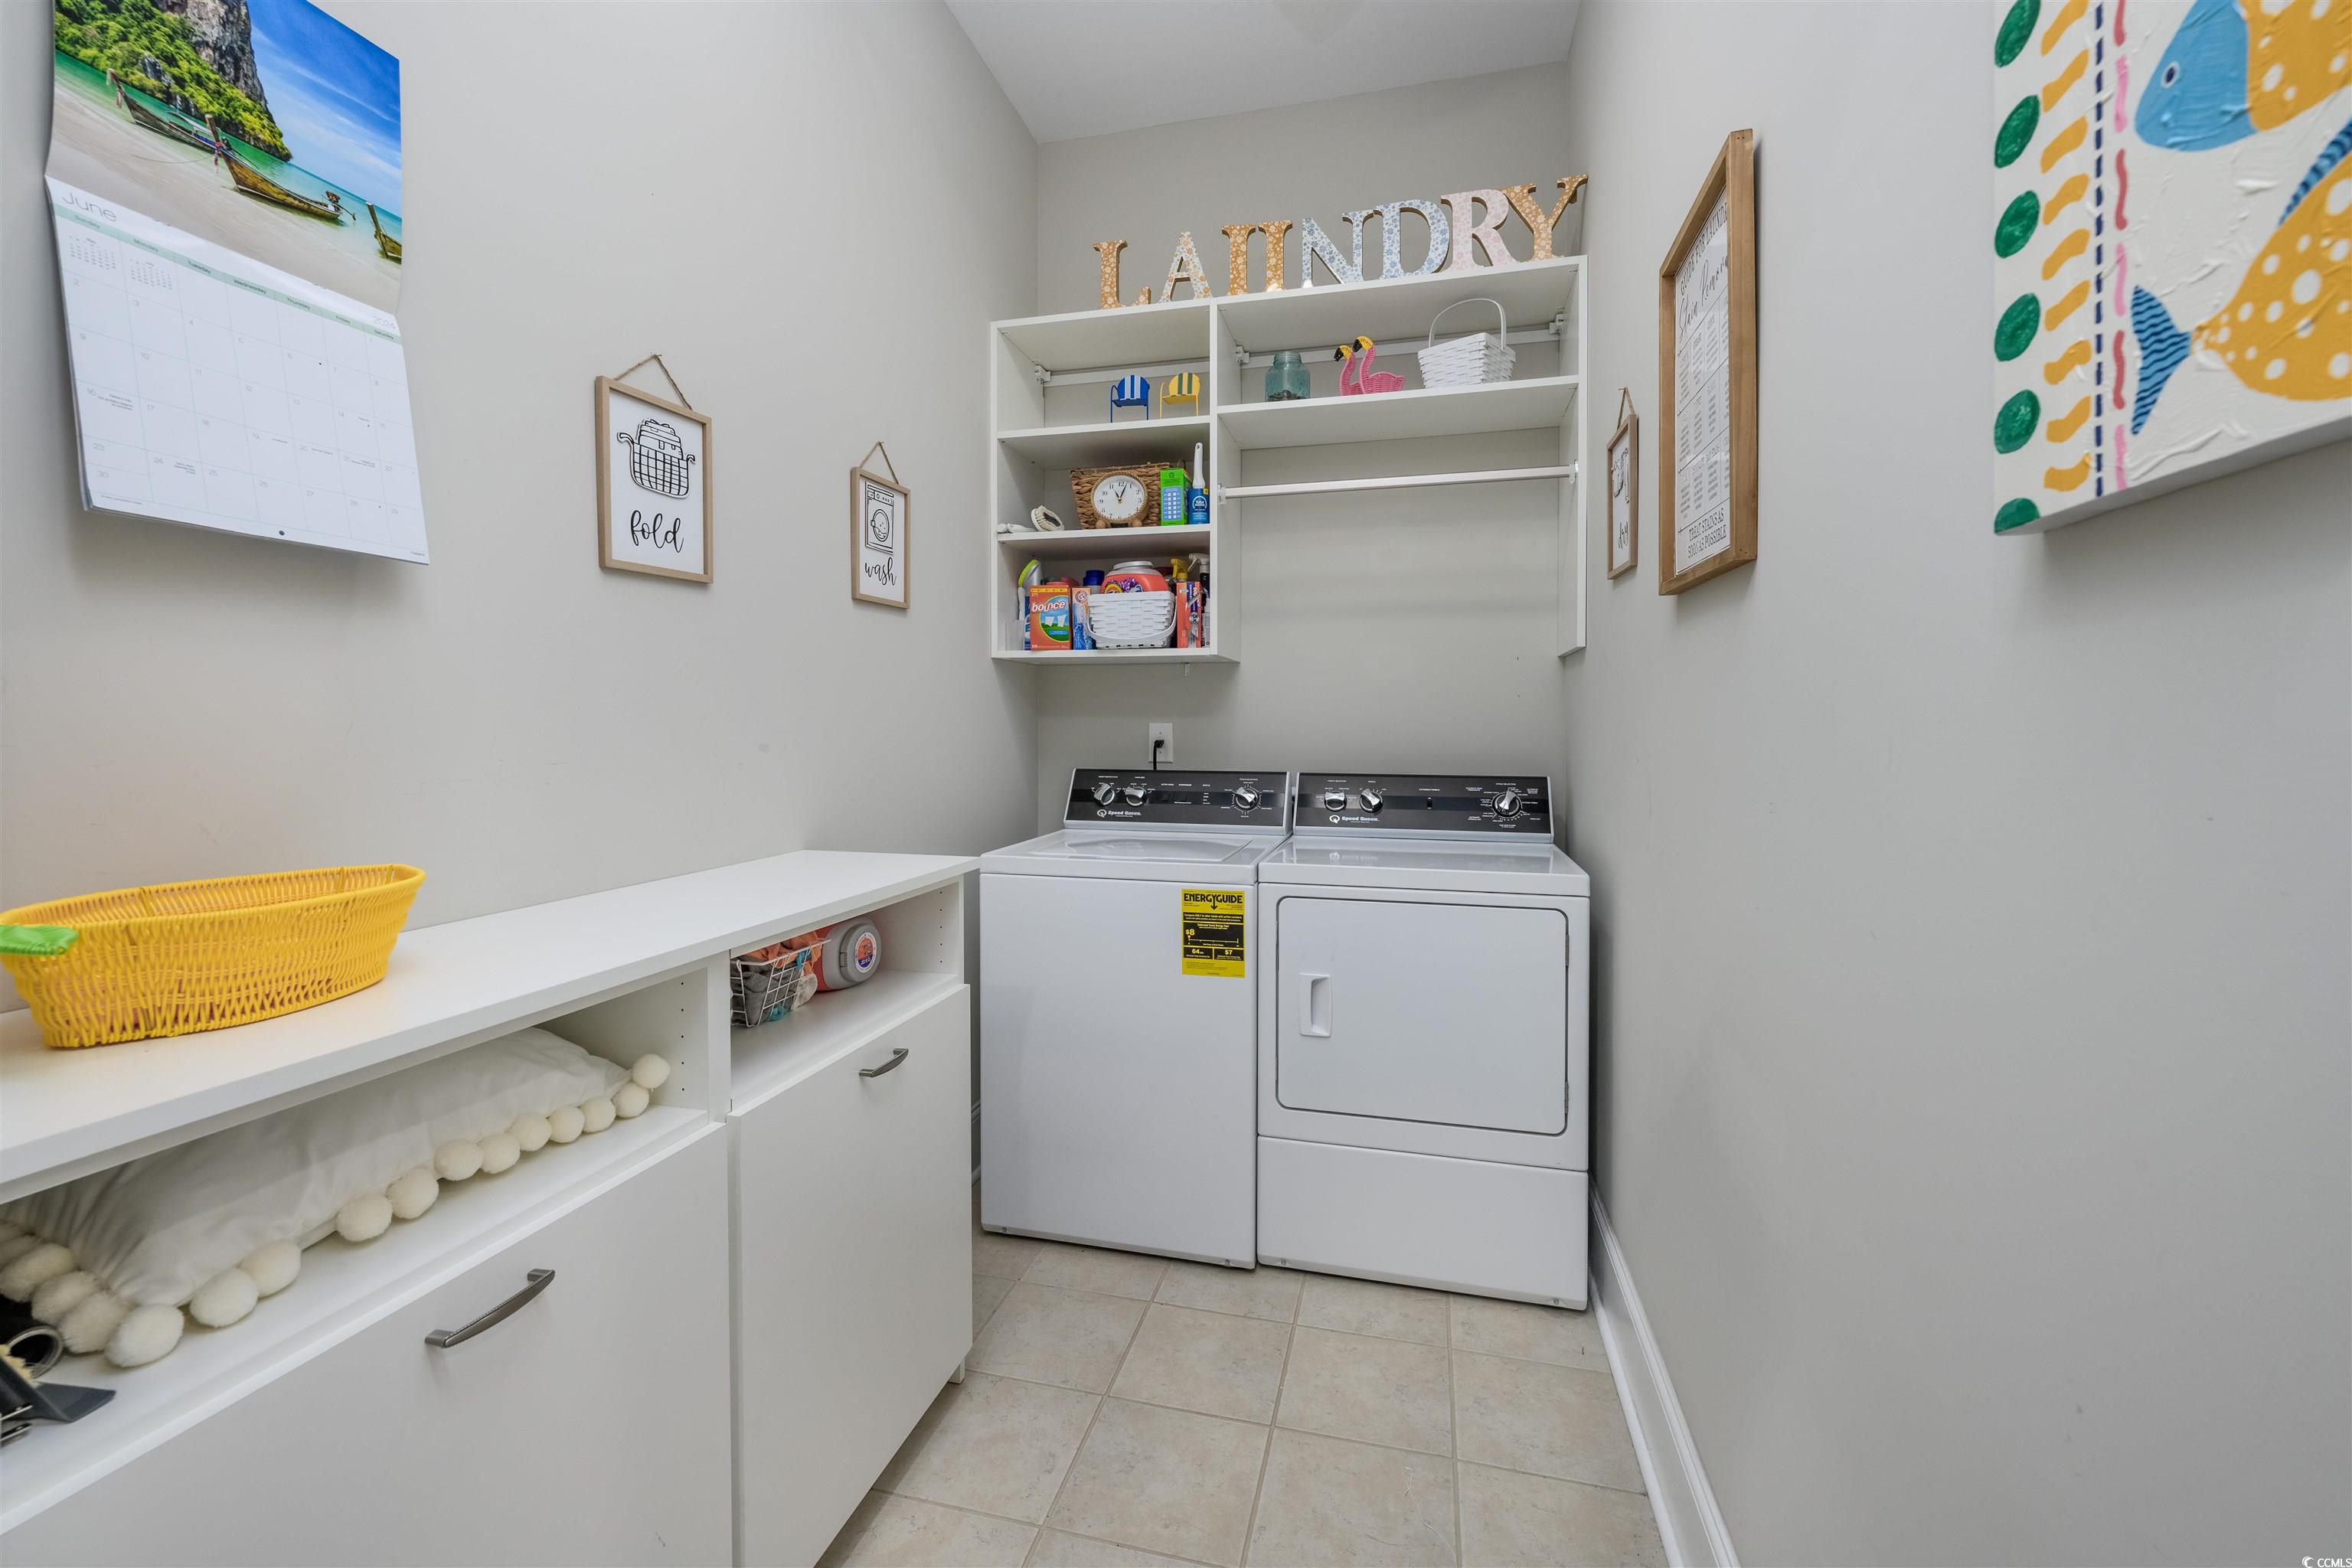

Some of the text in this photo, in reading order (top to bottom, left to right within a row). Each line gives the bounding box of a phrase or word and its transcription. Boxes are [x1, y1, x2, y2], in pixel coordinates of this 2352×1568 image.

[63, 192, 116, 222] June
[74, 215, 100, 229] Sunday
[133, 238, 158, 253] Monday
[188, 260, 211, 274] Tuesday
[234, 279, 266, 294] Wednesday
[287, 297, 310, 309] Thursday
[335, 315, 351, 325] Friday
[374, 329, 394, 340] Saturday
[1681, 253, 1695, 296] GUIDE
[1694, 237, 1706, 263] FOR
[373, 315, 395, 329] 2024
[1679, 293, 1698, 344] Stain
[629, 509, 684, 553] fold
[1618, 521, 1628, 550] dry
[1688, 507, 1724, 542] TREAT STAINS AS
[1704, 524, 1727, 549] POSSIBLE
[864, 557, 897, 586] wash
[1032, 600, 1066, 612] bounce
[1183, 893, 1243, 904] ENERGYGUIDE
